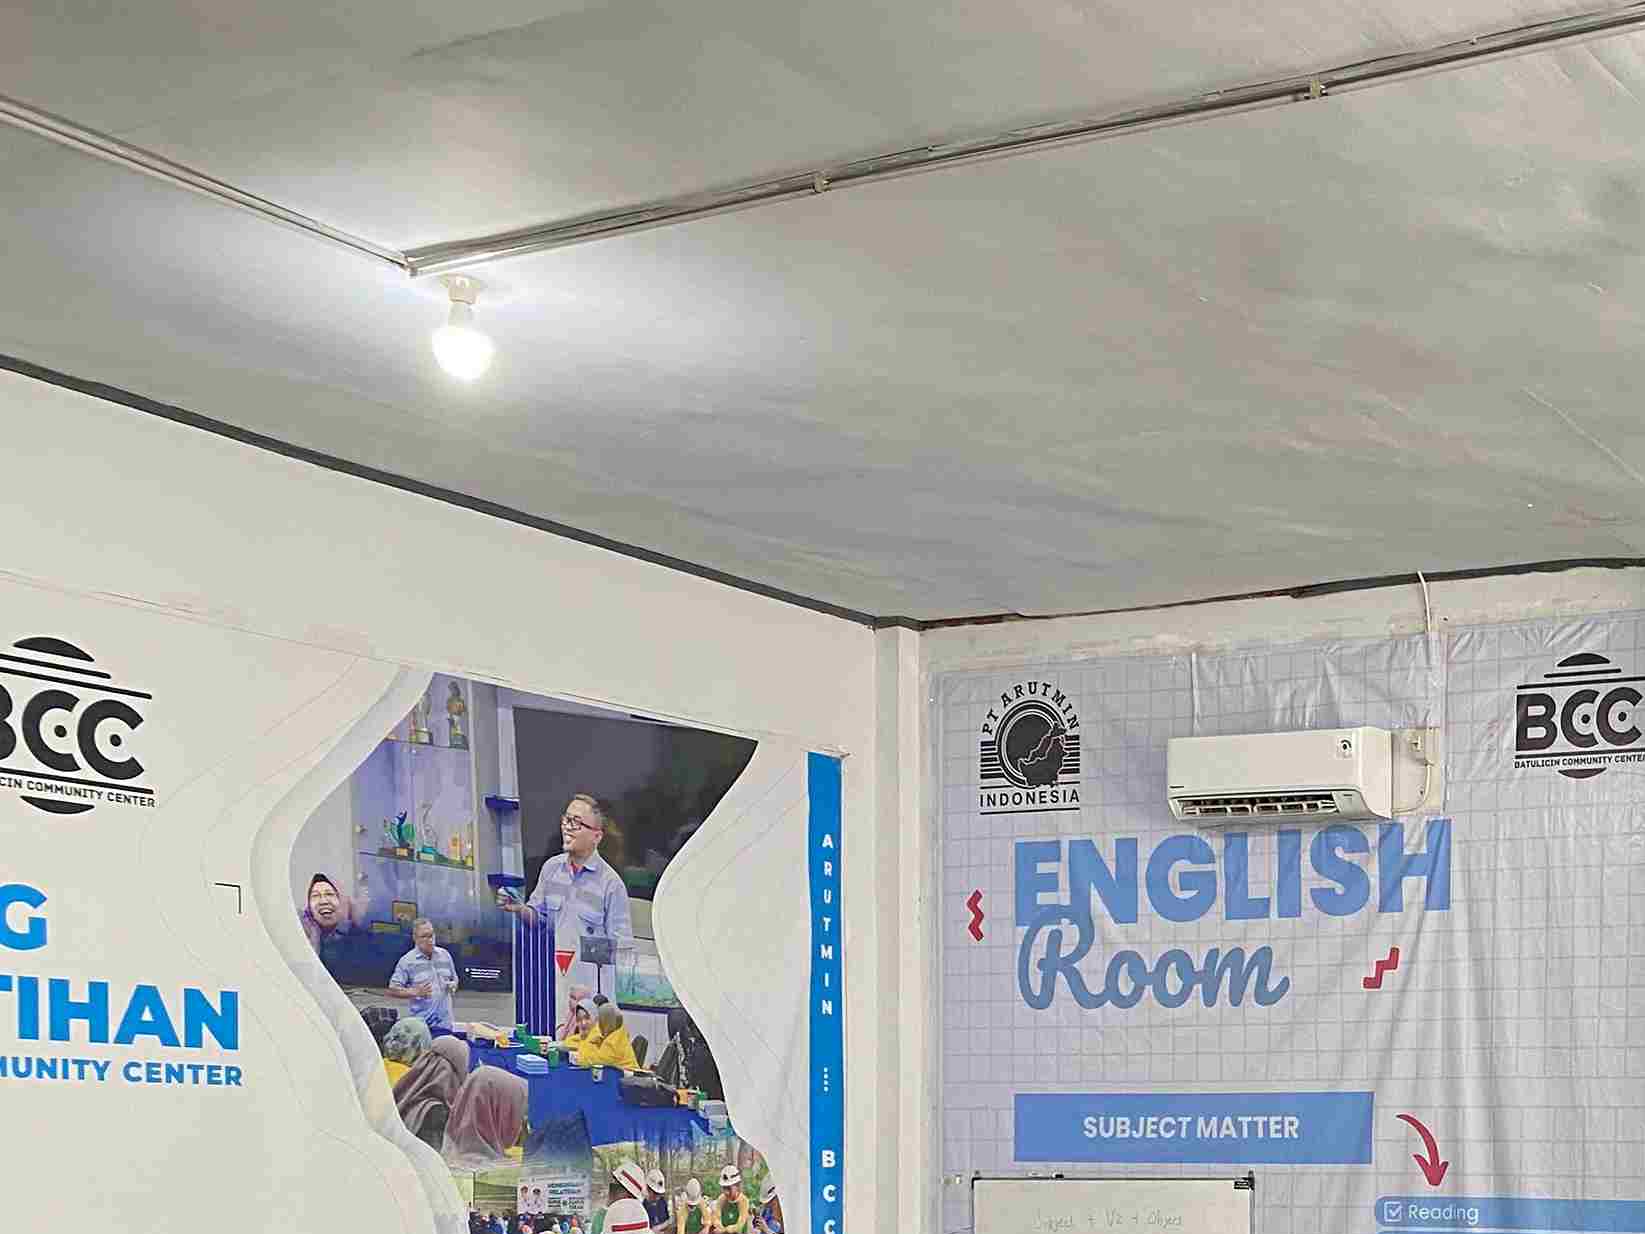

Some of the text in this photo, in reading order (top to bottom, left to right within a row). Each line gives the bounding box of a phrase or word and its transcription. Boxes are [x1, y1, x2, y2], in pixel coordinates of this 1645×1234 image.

[0, 684, 144, 780] CC
[982, 681, 1080, 735] PT ARUTMIN
[1516, 687, 1643, 751] BCC
[1562, 755, 1613, 766] COMMUNITY
[27, 780, 102, 799] COMMUNITY
[107, 792, 155, 807] CENTER
[980, 789, 1080, 807] INDONESIA
[1015, 818, 1452, 927] ENGLISH
[821, 833, 834, 1016] ARUTMIN
[1018, 905, 1290, 1010] Room
[0, 974, 239, 1050] IHAN
[123, 1061, 242, 1086] CENTER
[1083, 1115, 1300, 1139] SUBJECT MATTER
[1407, 1204, 1479, 1225] Reading
